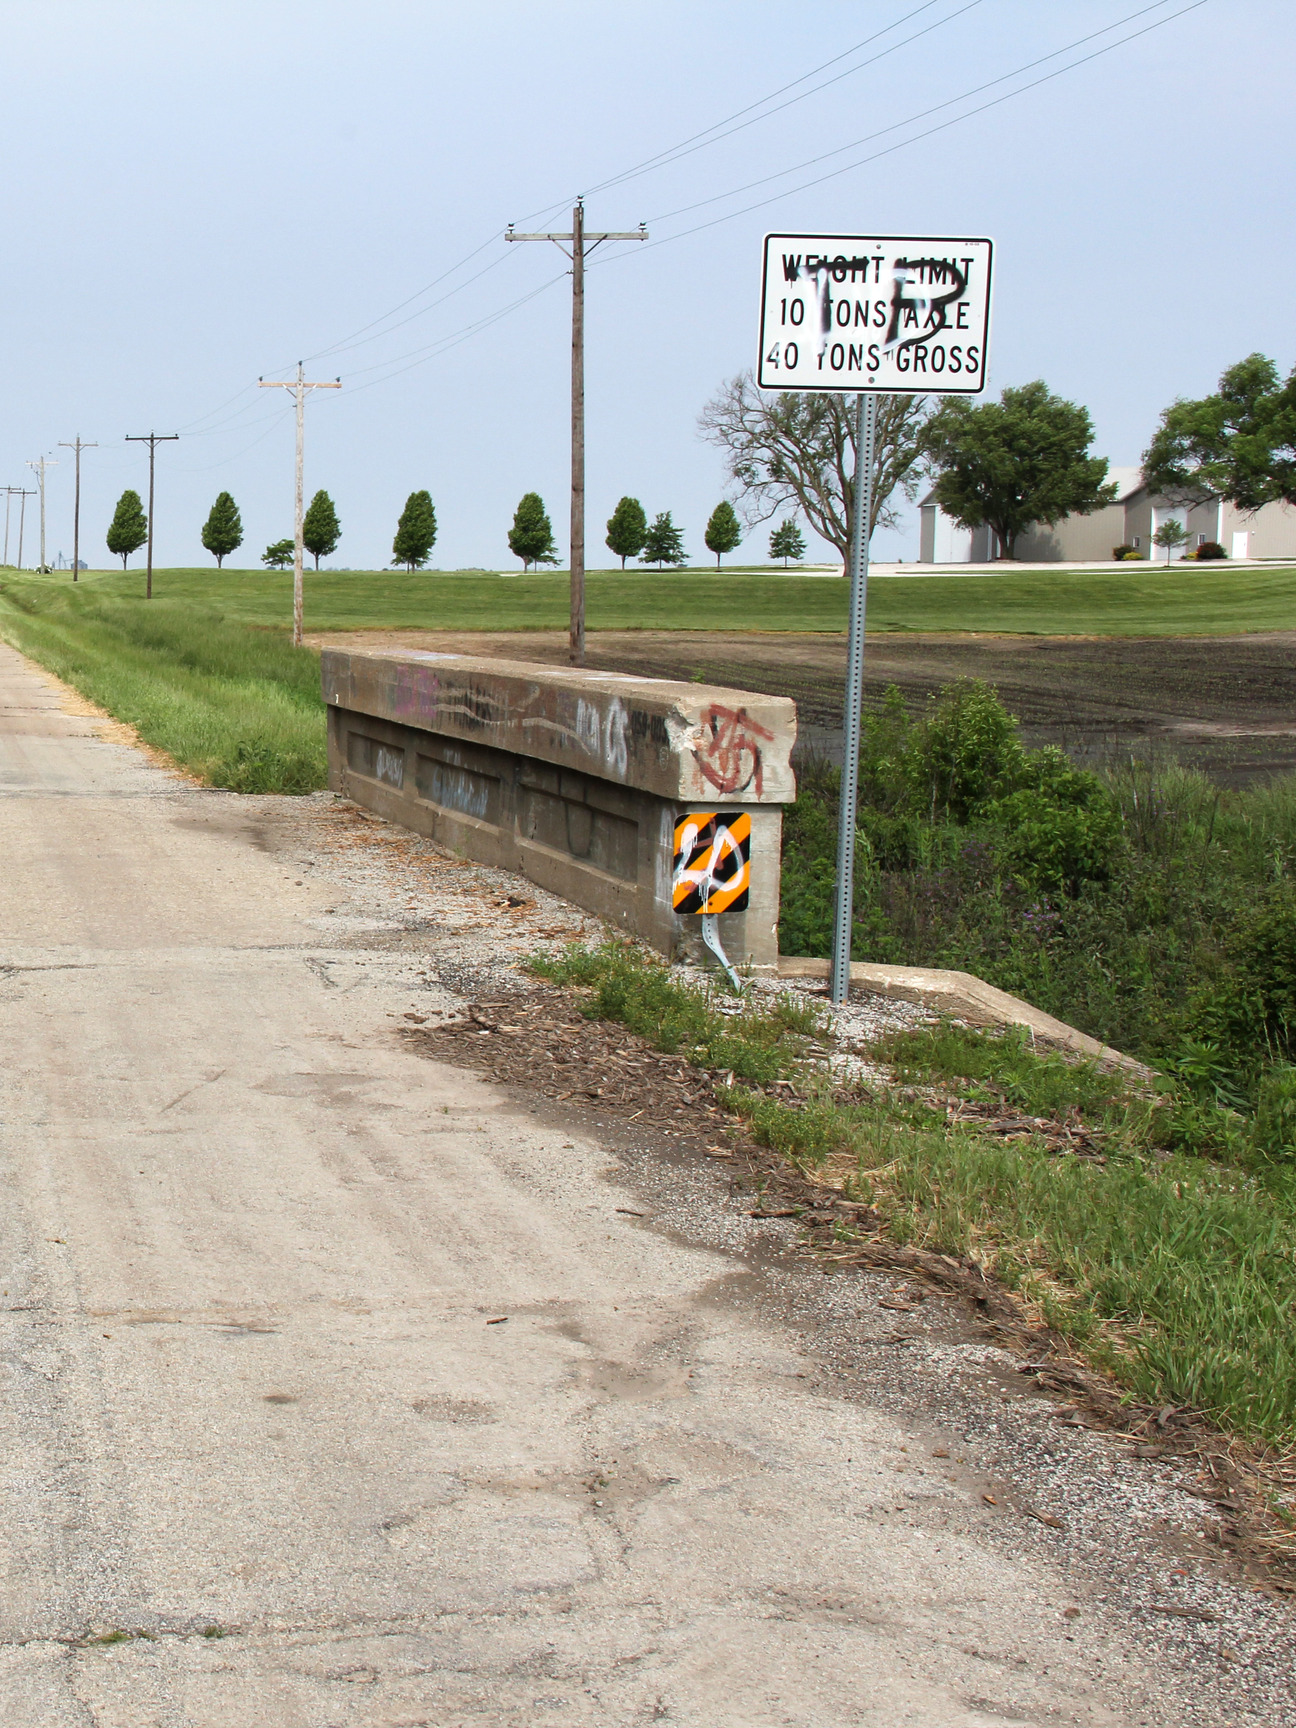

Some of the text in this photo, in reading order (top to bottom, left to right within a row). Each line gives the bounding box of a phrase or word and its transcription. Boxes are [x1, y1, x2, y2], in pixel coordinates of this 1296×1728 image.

[782, 254, 885, 284] WEGHT
[781, 298, 805, 327] 10
[818, 299, 886, 328] ONS
[766, 341, 799, 370] 40
[896, 344, 980, 373] GROSS
